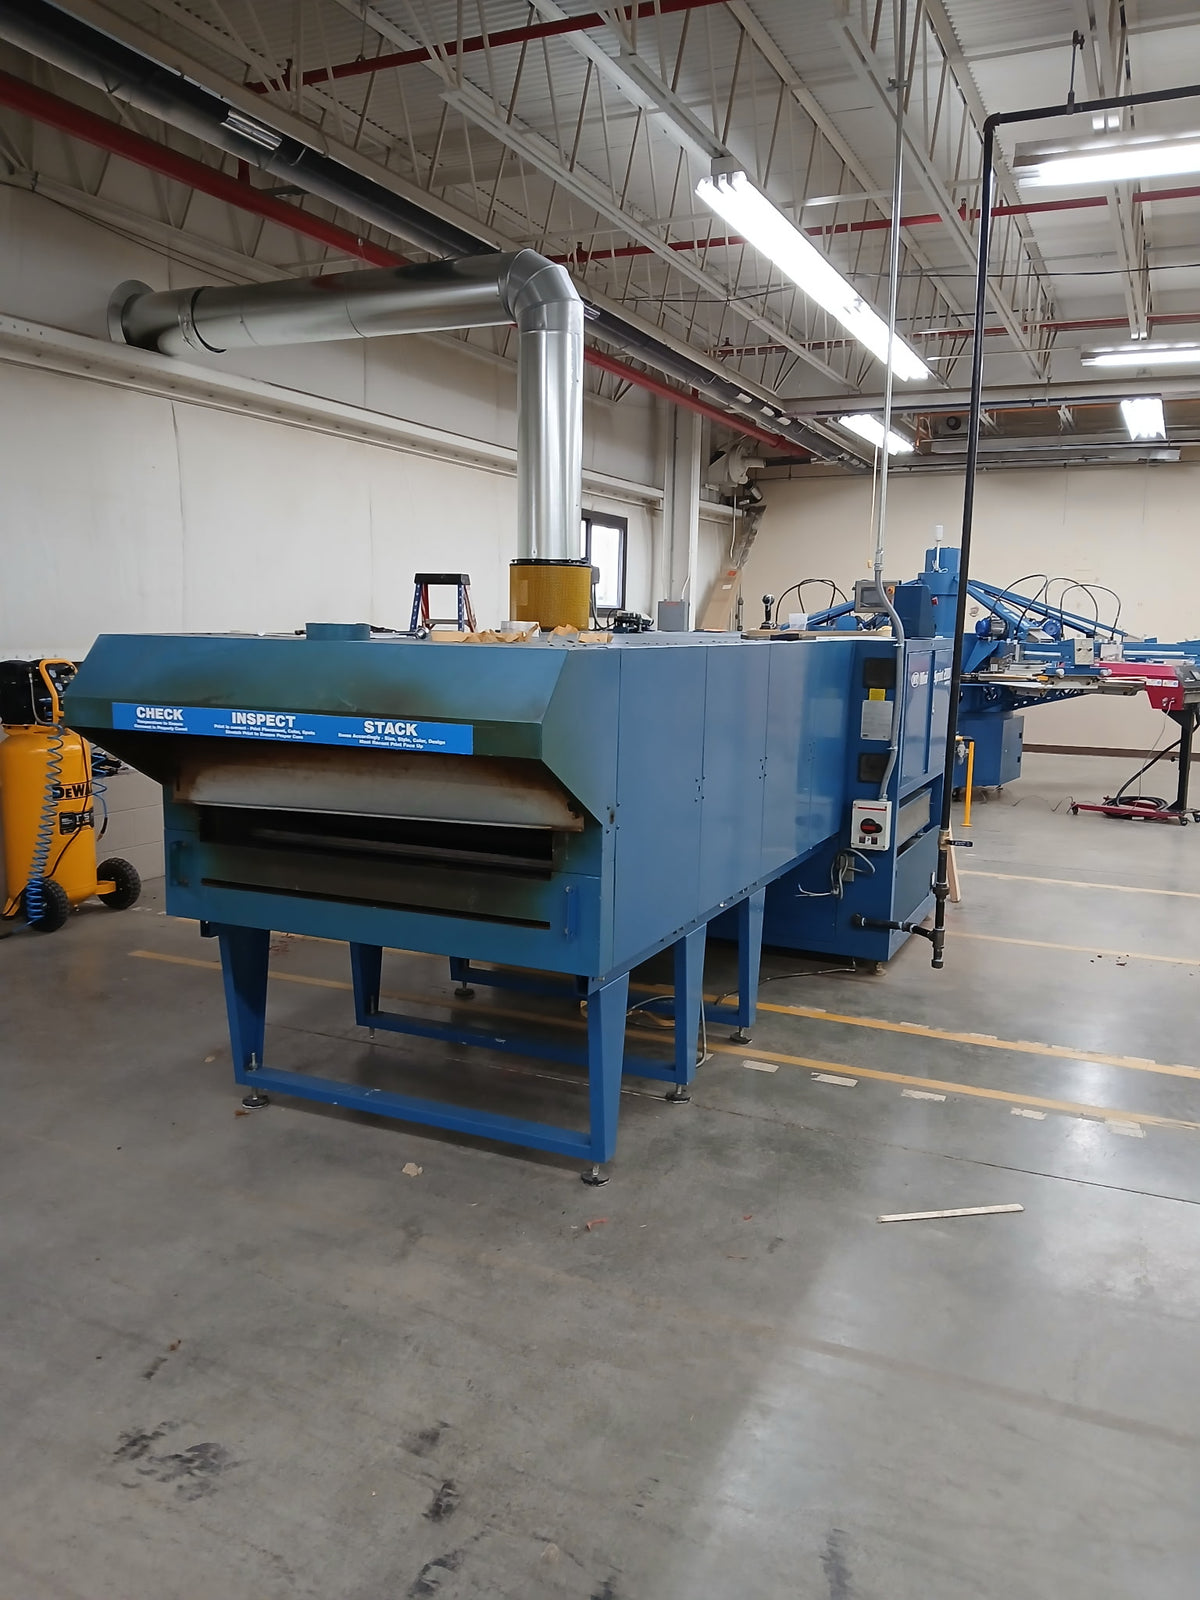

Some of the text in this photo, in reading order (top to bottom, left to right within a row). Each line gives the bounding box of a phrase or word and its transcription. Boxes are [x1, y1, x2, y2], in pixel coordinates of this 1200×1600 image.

[136, 706, 184, 721] CHECK
[231, 712, 296, 728] INSPECT
[363, 720, 418, 737] STACK
